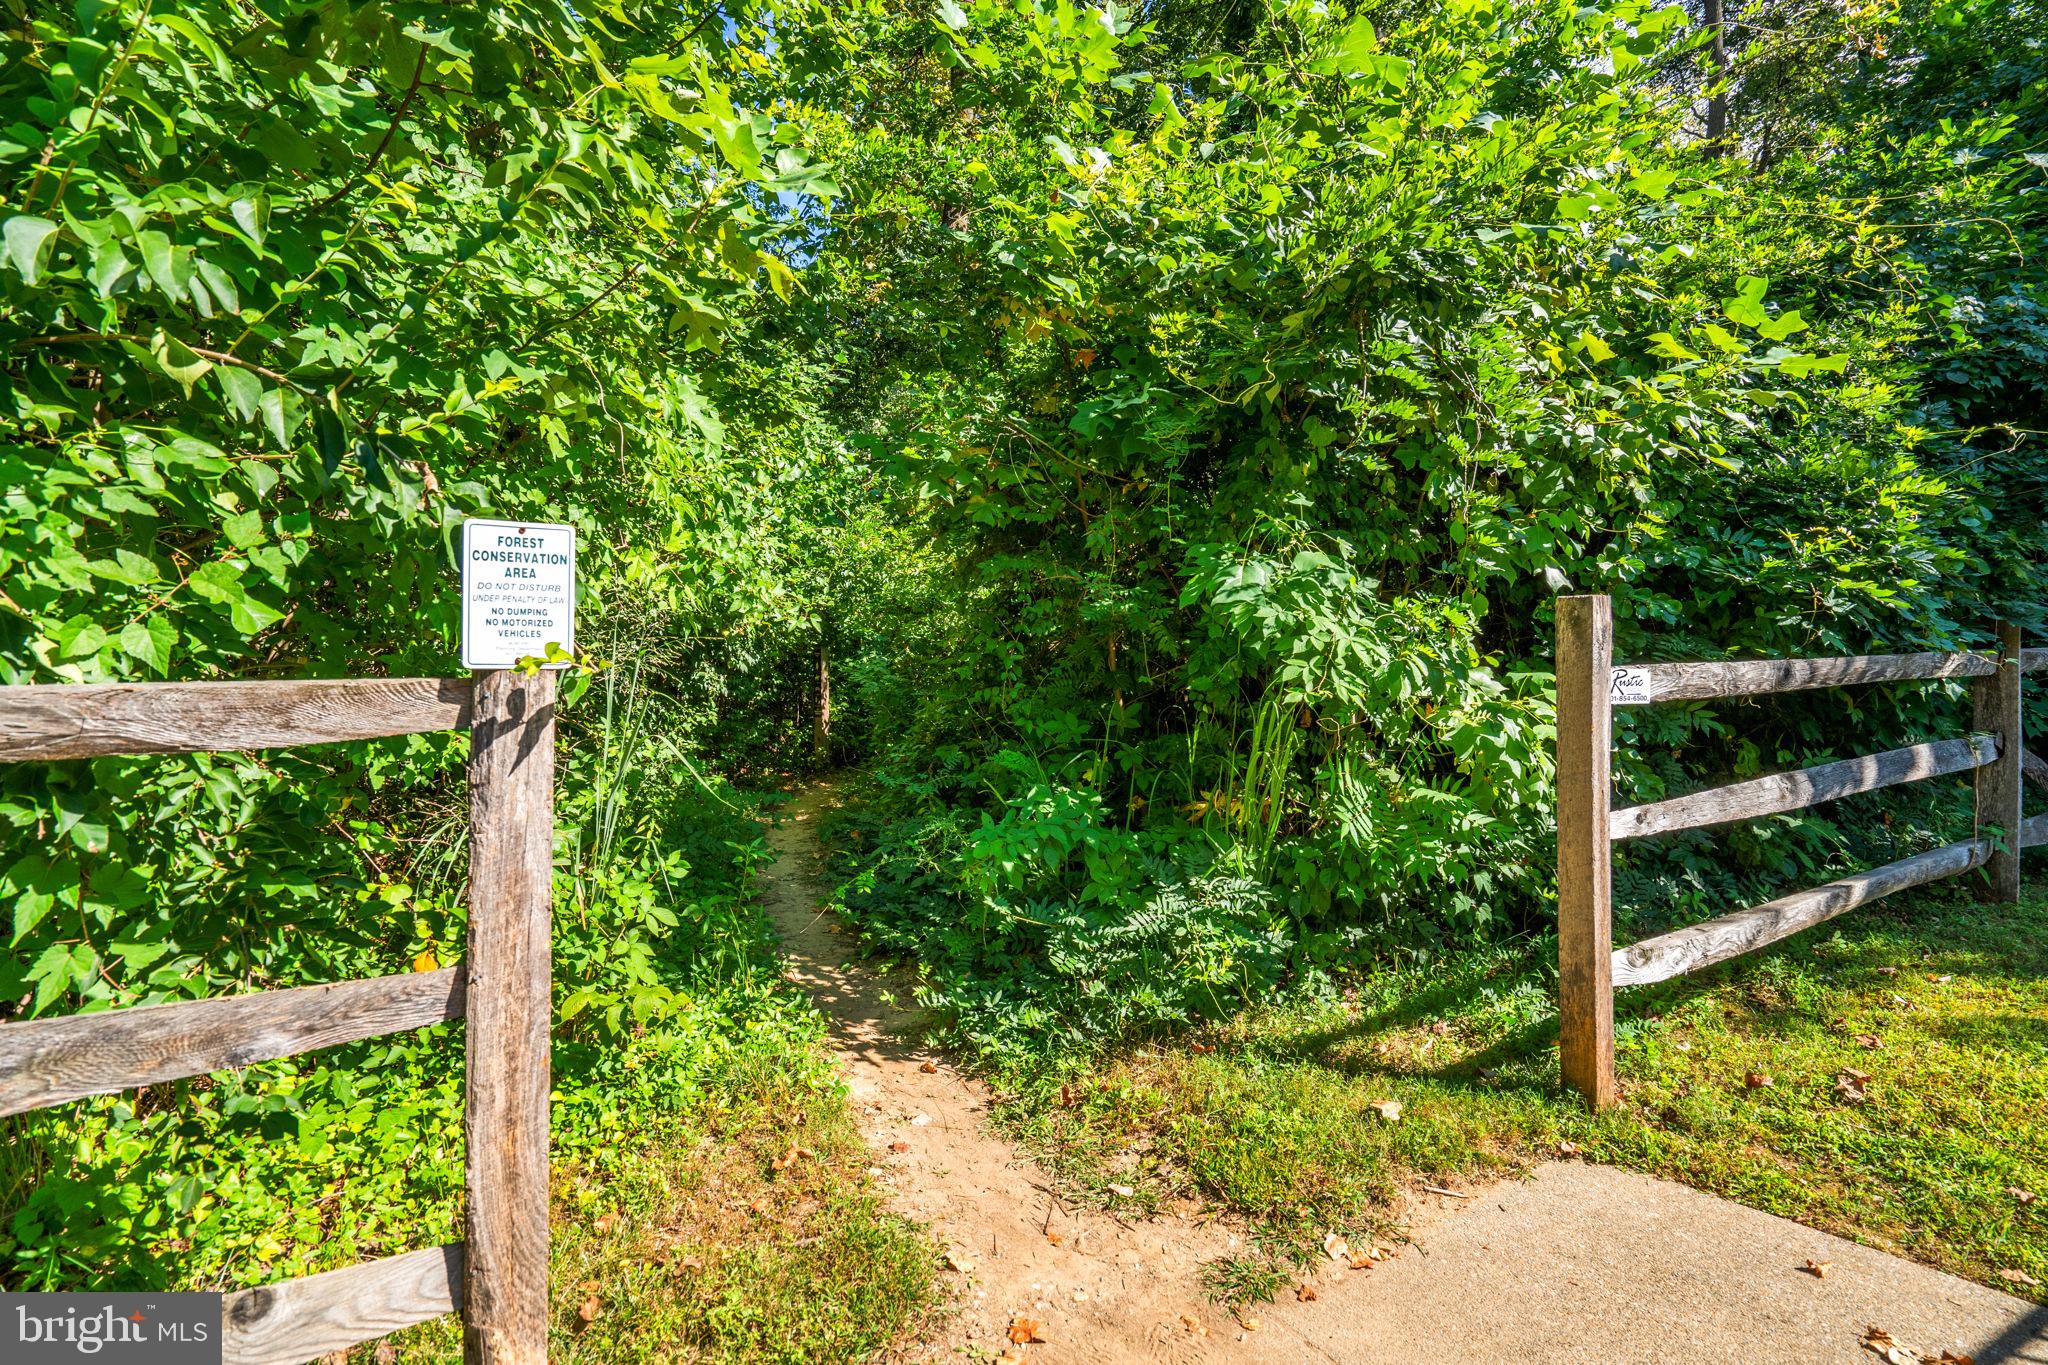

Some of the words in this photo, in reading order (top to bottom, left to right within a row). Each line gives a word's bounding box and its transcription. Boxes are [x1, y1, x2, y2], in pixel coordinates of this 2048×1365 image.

[498, 536, 544, 548] FOREST
[472, 550, 567, 565] CONSERVATION
[504, 568, 536, 578] AREA
[477, 582, 492, 590] DO
[495, 583, 516, 591] NOT
[519, 584, 561, 592] DISTURB
[507, 608, 548, 616] DUMPING
[502, 619, 553, 627] MOTORIZED
[1611, 669, 1643, 695] Rustic
